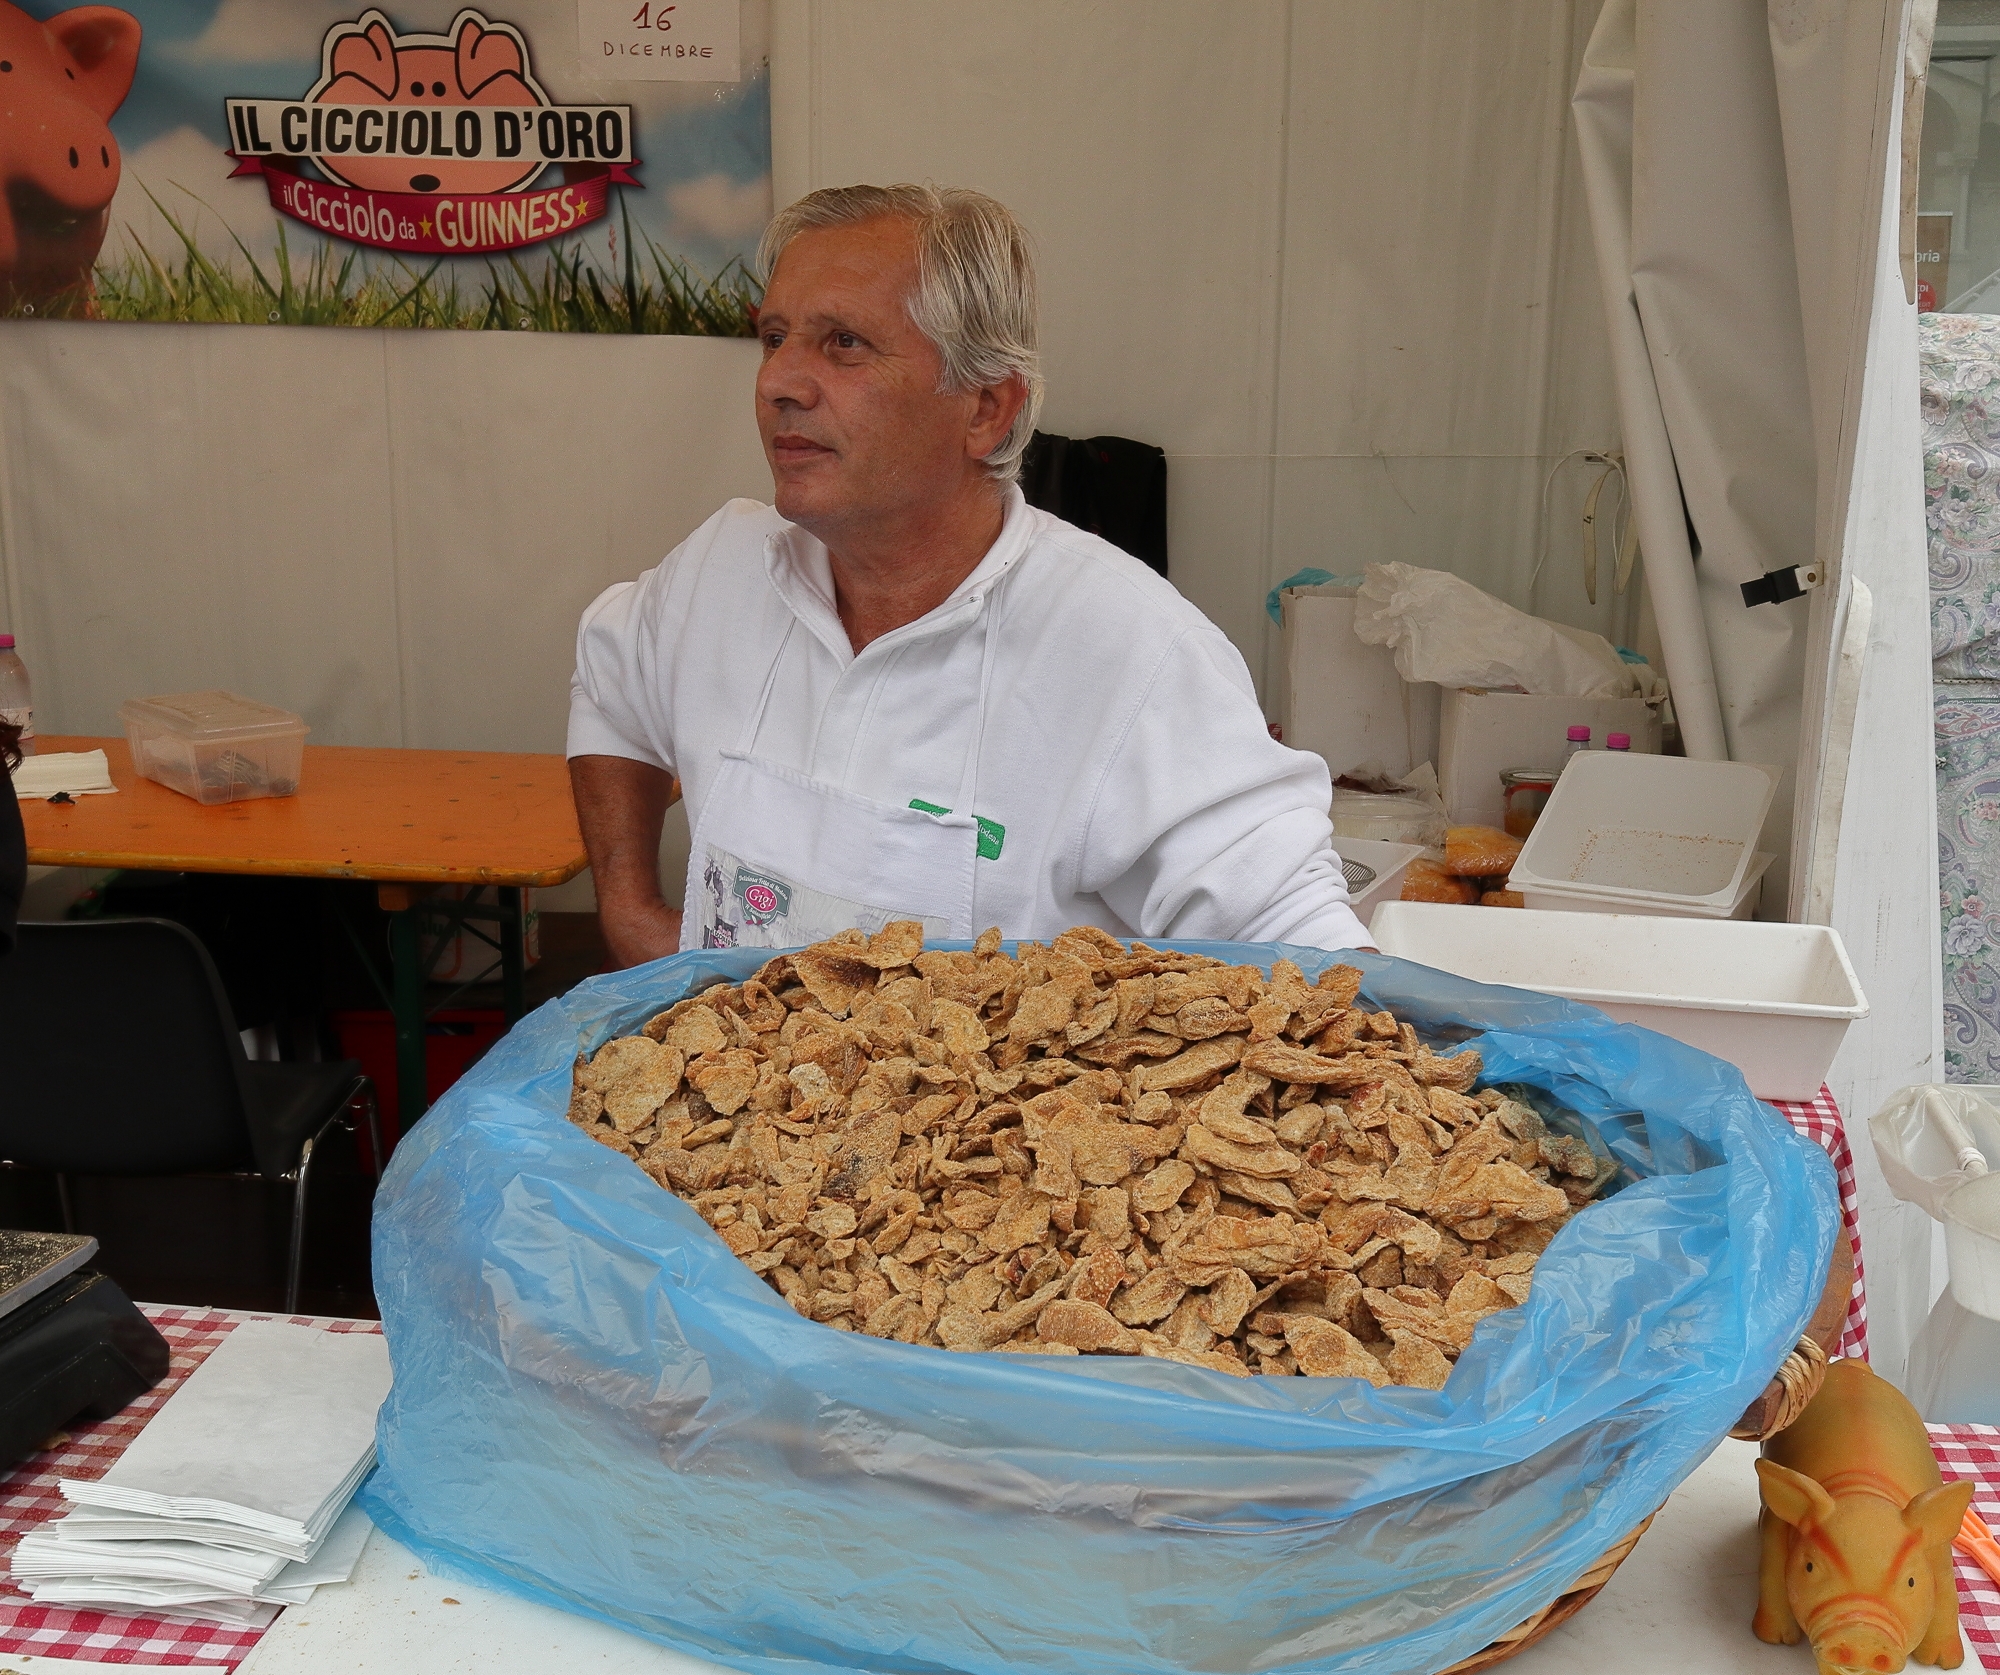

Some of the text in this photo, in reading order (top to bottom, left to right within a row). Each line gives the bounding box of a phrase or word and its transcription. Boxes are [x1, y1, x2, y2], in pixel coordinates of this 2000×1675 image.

[632, 2, 676, 31] 16
[603, 41, 714, 58] DICEMBRE
[233, 105, 623, 159] IL CICCIOLO D'ORO
[283, 181, 575, 248] il Cicciolo da GUINNESS
[749, 888, 775, 909] Gigi
